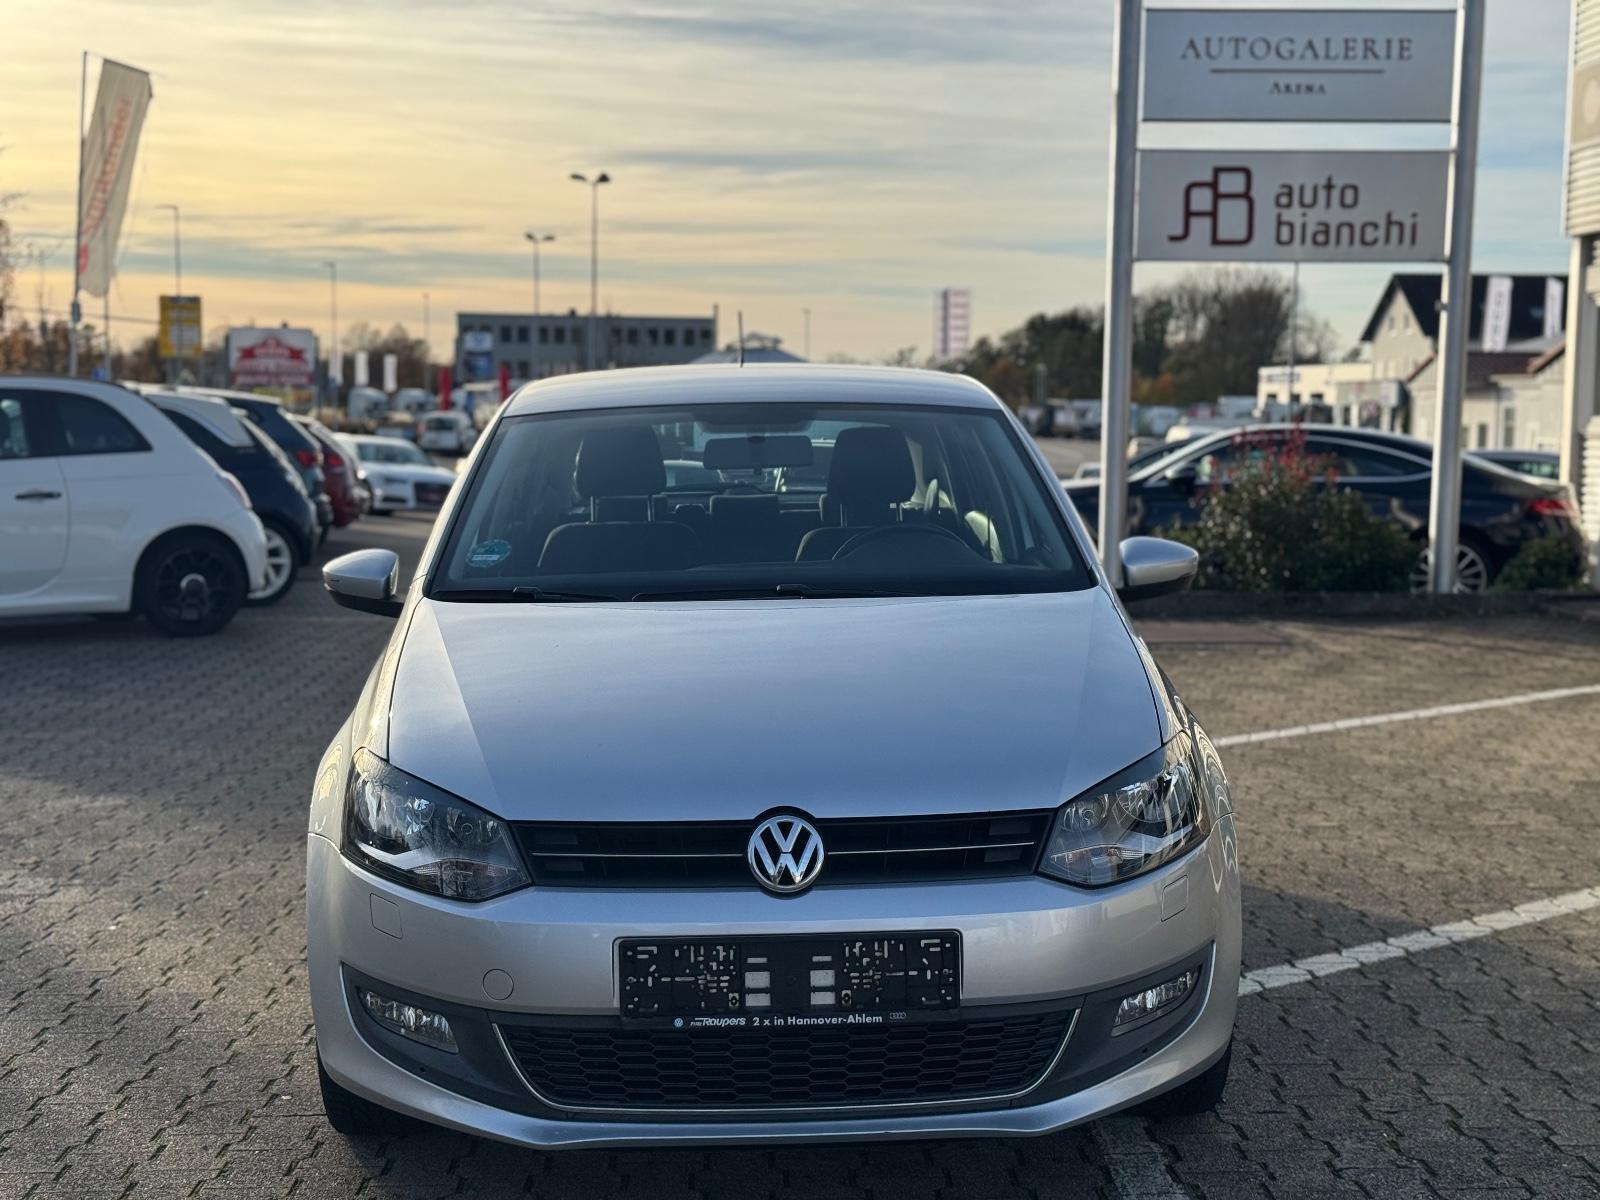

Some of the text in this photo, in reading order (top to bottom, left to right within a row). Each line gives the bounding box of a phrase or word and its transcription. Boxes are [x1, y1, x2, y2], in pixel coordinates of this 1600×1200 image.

[1180, 36, 1414, 61] AUTOGALERIE
[1274, 175, 1360, 209] auto
[1275, 211, 1419, 247] bianchi
[701, 1017, 747, 1028] Raupers
[752, 1016, 760, 1027] 2
[763, 1018, 771, 1027] x
[774, 1016, 785, 1026] in
[787, 1014, 883, 1026] Hannover-Ahlem
